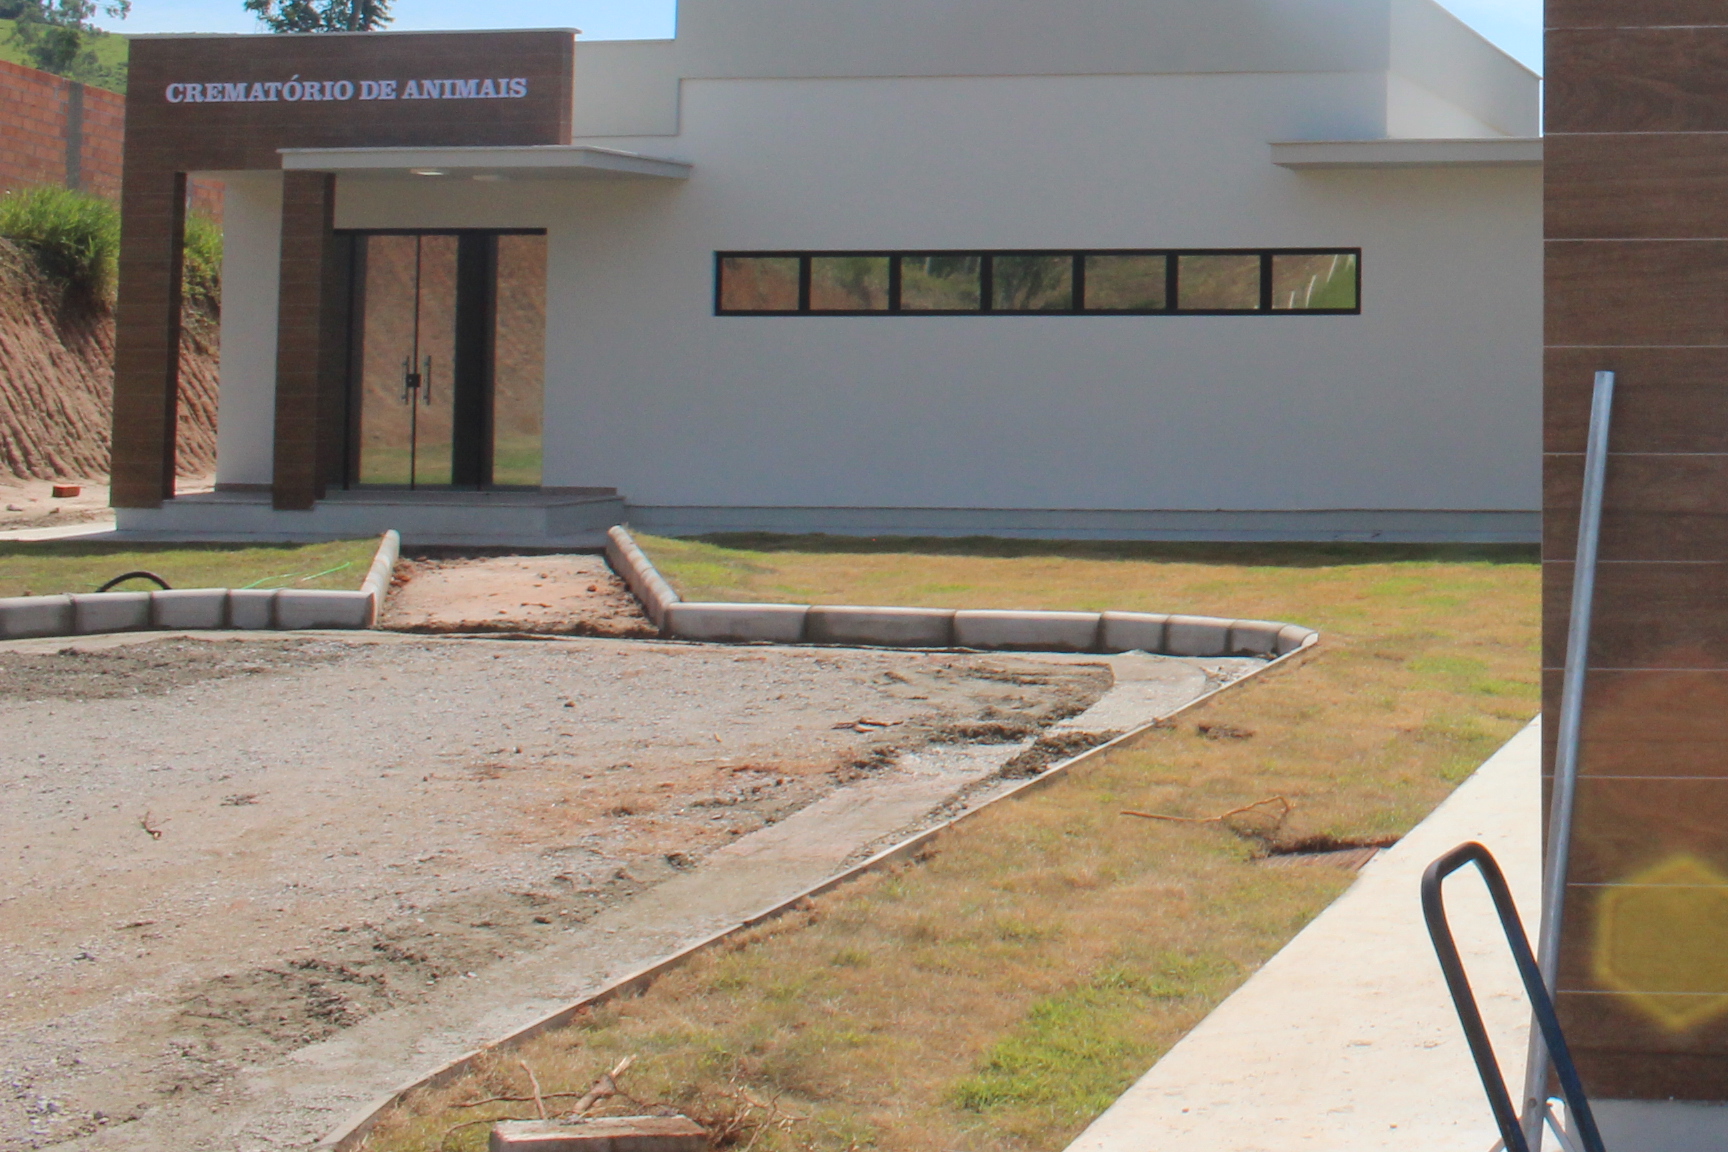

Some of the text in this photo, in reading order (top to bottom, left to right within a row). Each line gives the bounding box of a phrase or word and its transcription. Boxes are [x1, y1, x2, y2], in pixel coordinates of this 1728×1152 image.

[164, 75, 528, 103] CREMATÓRIO DE ANIMAIS
